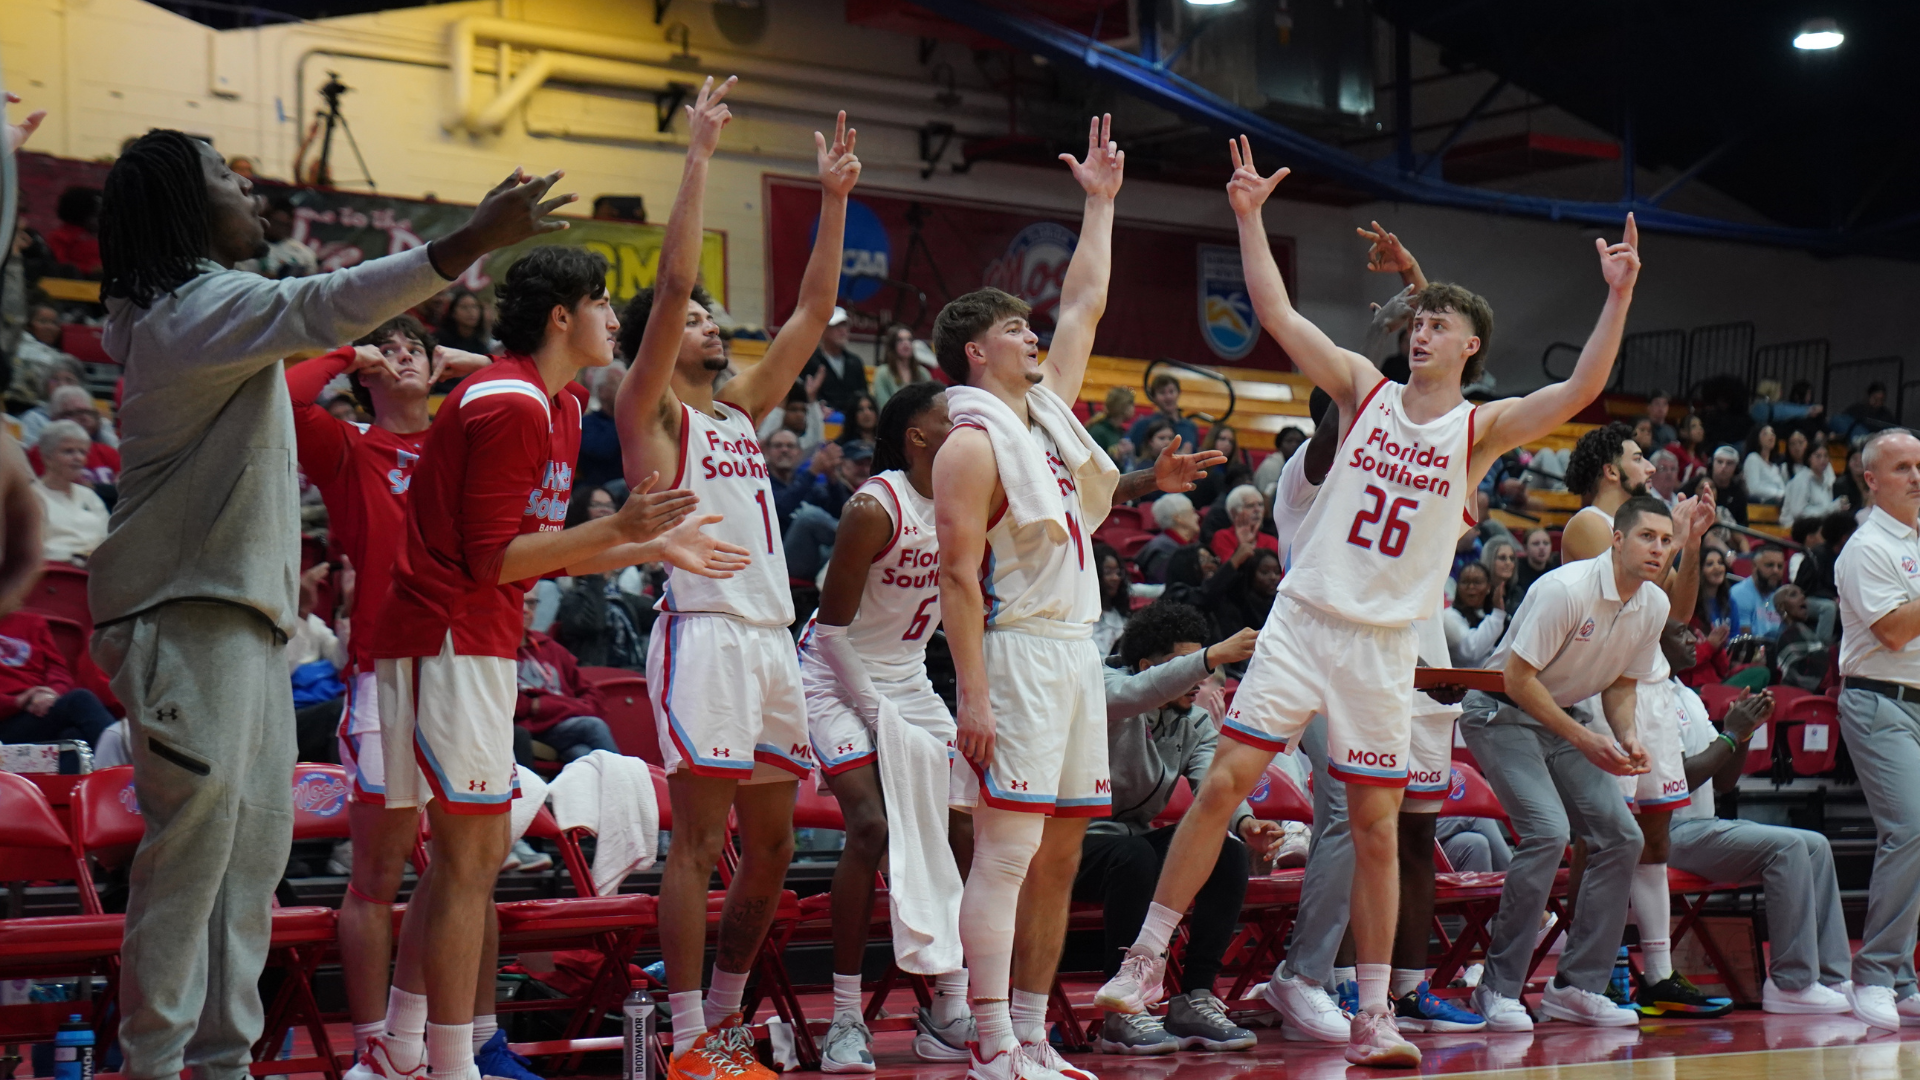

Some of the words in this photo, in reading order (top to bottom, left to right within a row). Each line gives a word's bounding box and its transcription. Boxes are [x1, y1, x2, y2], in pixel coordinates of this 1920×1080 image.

[841, 248, 888, 278] CAA
[1366, 427, 1450, 469] Florida
[1349, 448, 1451, 497] Southern
[755, 490, 774, 554] 1
[1347, 484, 1419, 557] 26
[899, 549, 939, 567] Flor
[902, 594, 938, 640] 6
[1347, 749, 1397, 768] MOCS
[1410, 771, 1441, 783] MOCS
[635, 1018, 643, 1072] BODYARMOR
